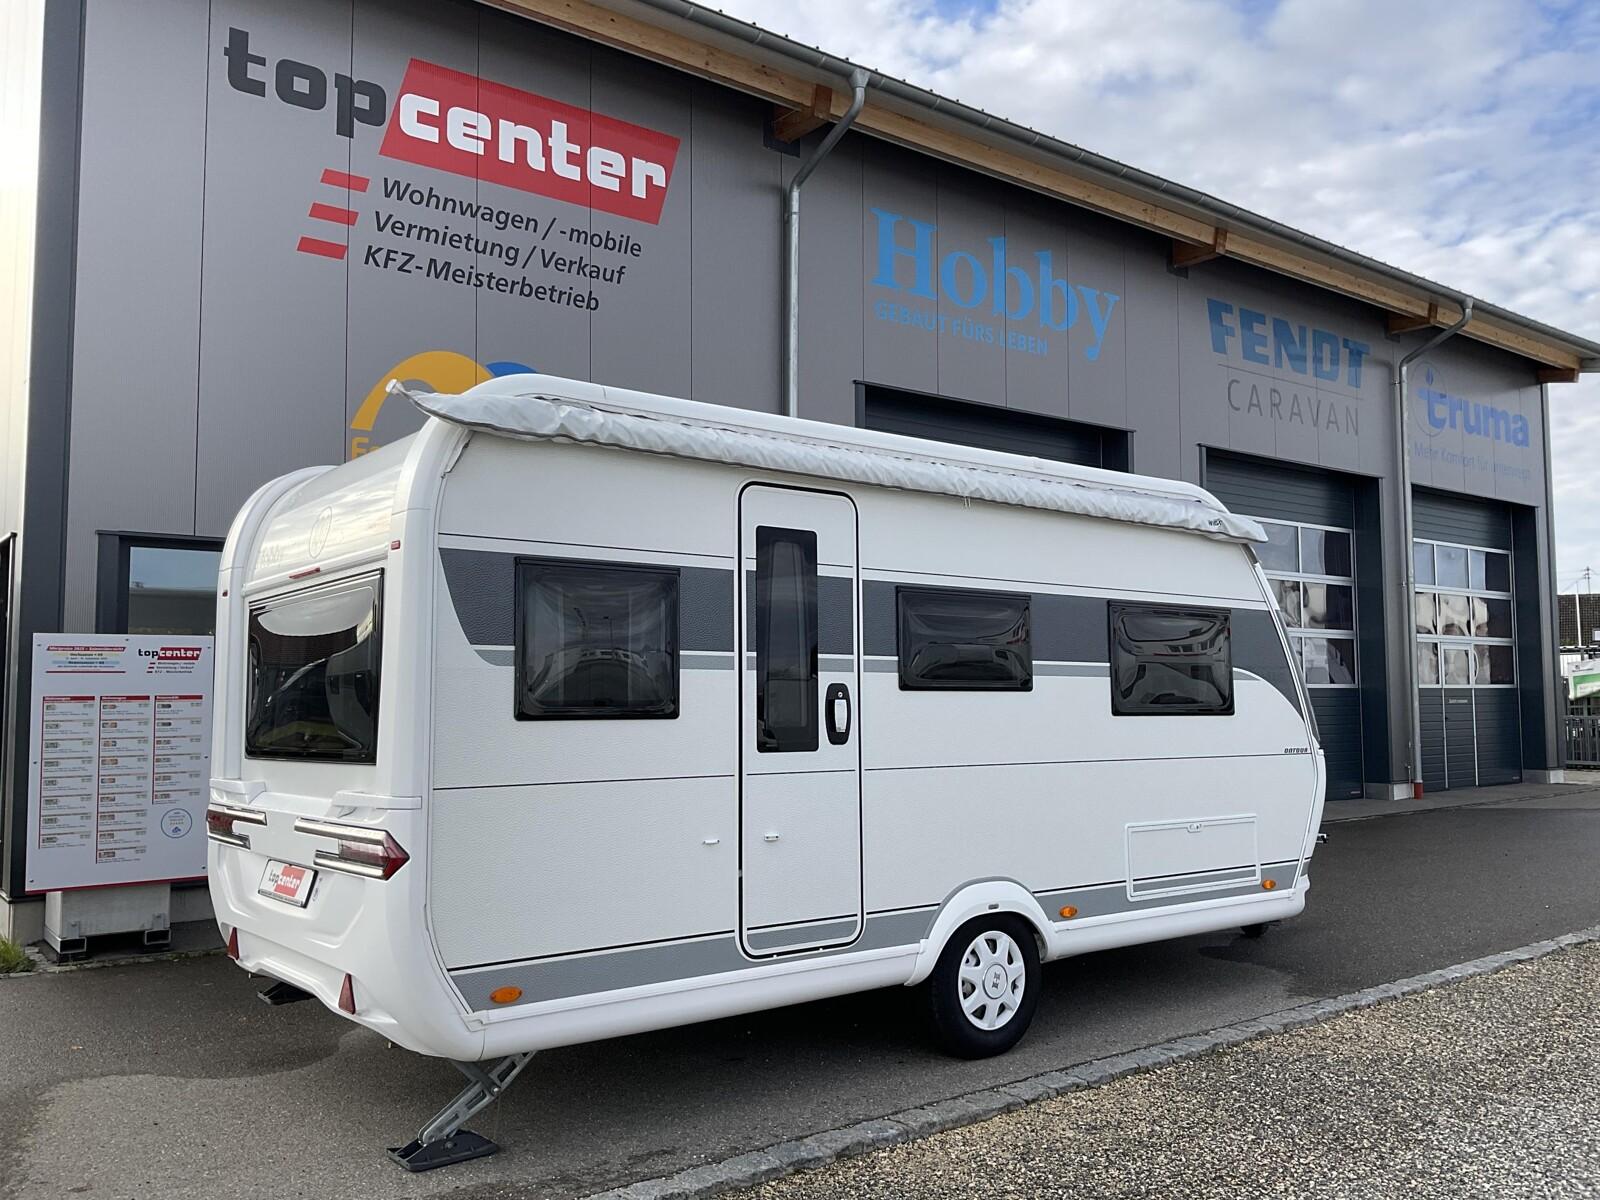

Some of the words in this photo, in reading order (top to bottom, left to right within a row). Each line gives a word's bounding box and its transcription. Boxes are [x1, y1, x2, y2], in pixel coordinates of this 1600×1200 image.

[382, 177, 539, 233] Wohnwagen
[373, 210, 521, 266] Vermietung
[363, 245, 600, 311] KFZ-Meisterbetrieb
[870, 207, 1121, 362] Hobby
[874, 298, 947, 334] GEBAUT
[952, 315, 994, 345] FÜRS
[999, 328, 1048, 357] LEBEN
[1207, 298, 1370, 389] FENDT
[1227, 378, 1360, 436] CARAVAN
[1417, 378, 1530, 448] truma
